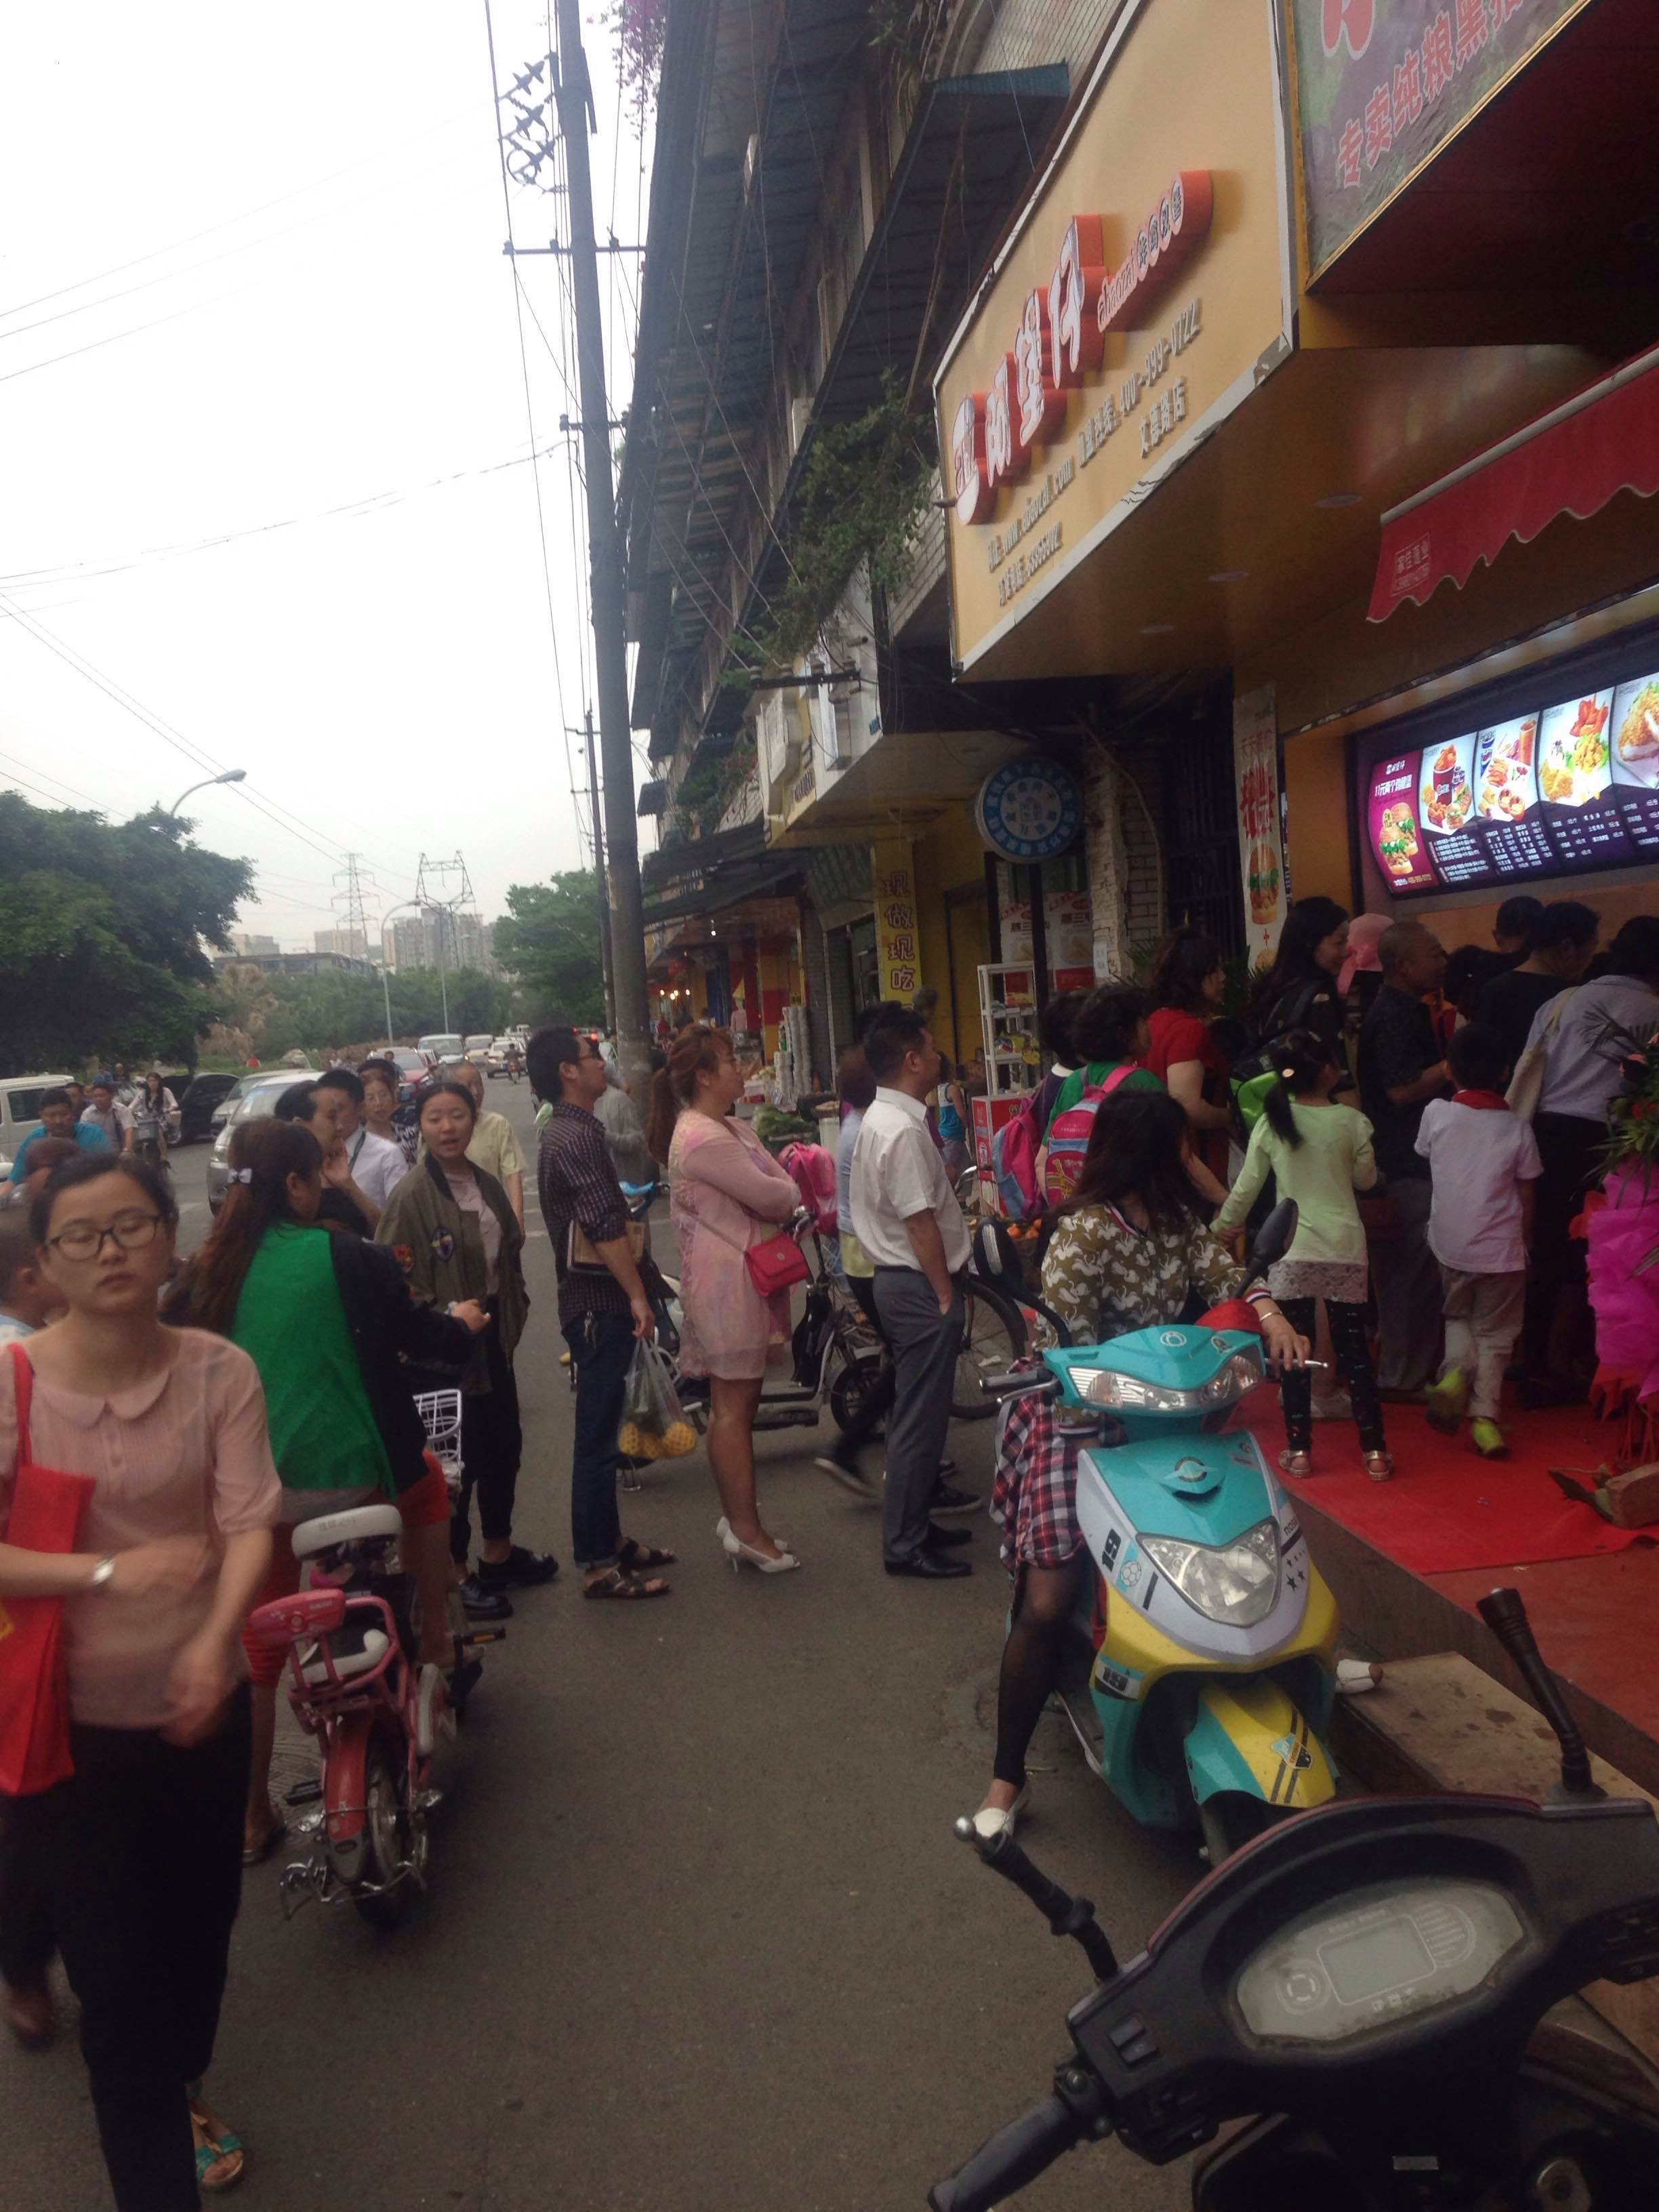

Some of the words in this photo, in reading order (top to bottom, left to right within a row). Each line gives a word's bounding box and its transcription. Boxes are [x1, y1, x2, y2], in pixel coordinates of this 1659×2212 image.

[1336, 0, 1523, 188] 专卖纯粮黑
[884, 871, 916, 1010] 现做现吃
[1101, 1528, 1122, 1573] 19
